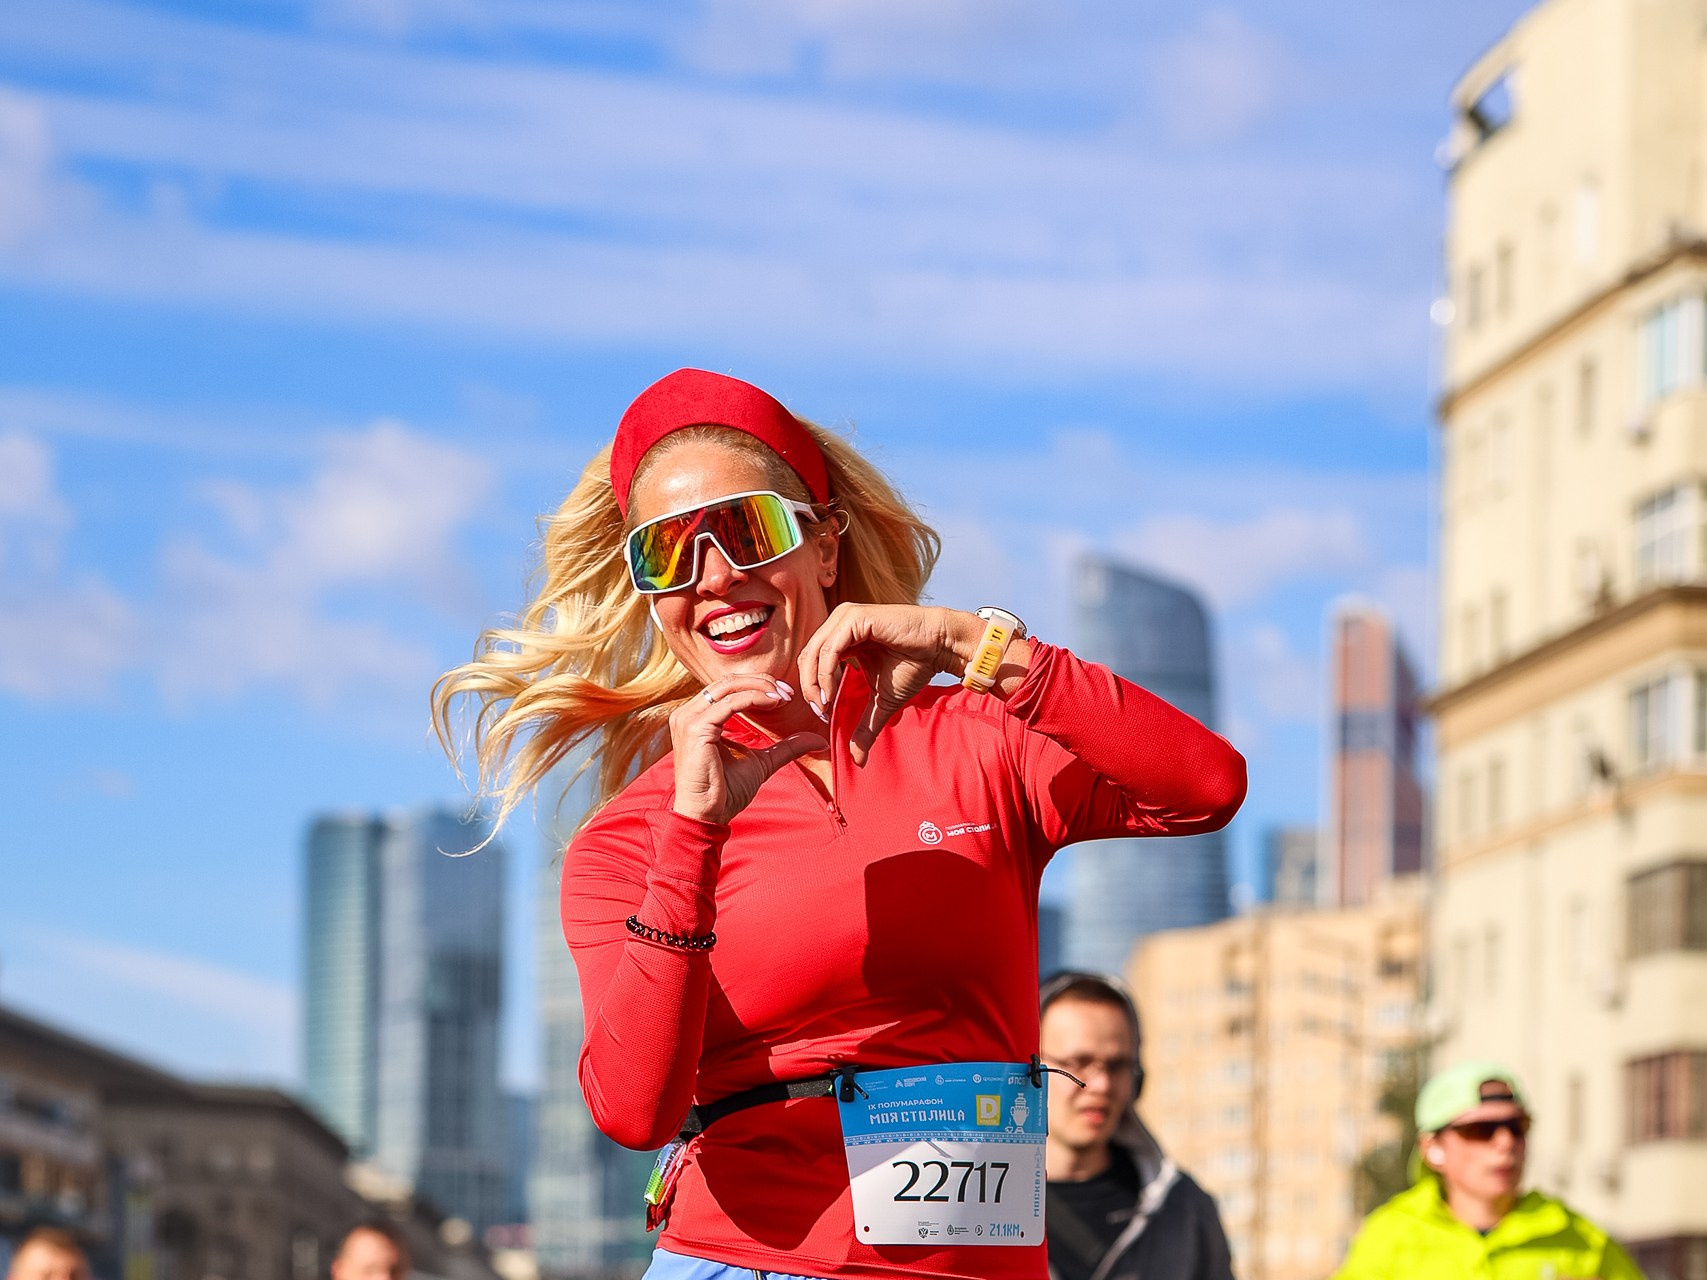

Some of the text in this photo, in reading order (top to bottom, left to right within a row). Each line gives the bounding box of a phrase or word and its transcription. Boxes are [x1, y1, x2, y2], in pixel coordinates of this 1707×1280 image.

[878, 1098, 944, 1109] ПОЛУМАРАФОН
[980, 1097, 998, 1119] D
[869, 1112, 899, 1125] МОЯ
[901, 1109, 966, 1123] СТОЛИЦА
[892, 1160, 1010, 1204] 22717
[1033, 1170, 1041, 1217] МОСКВА
